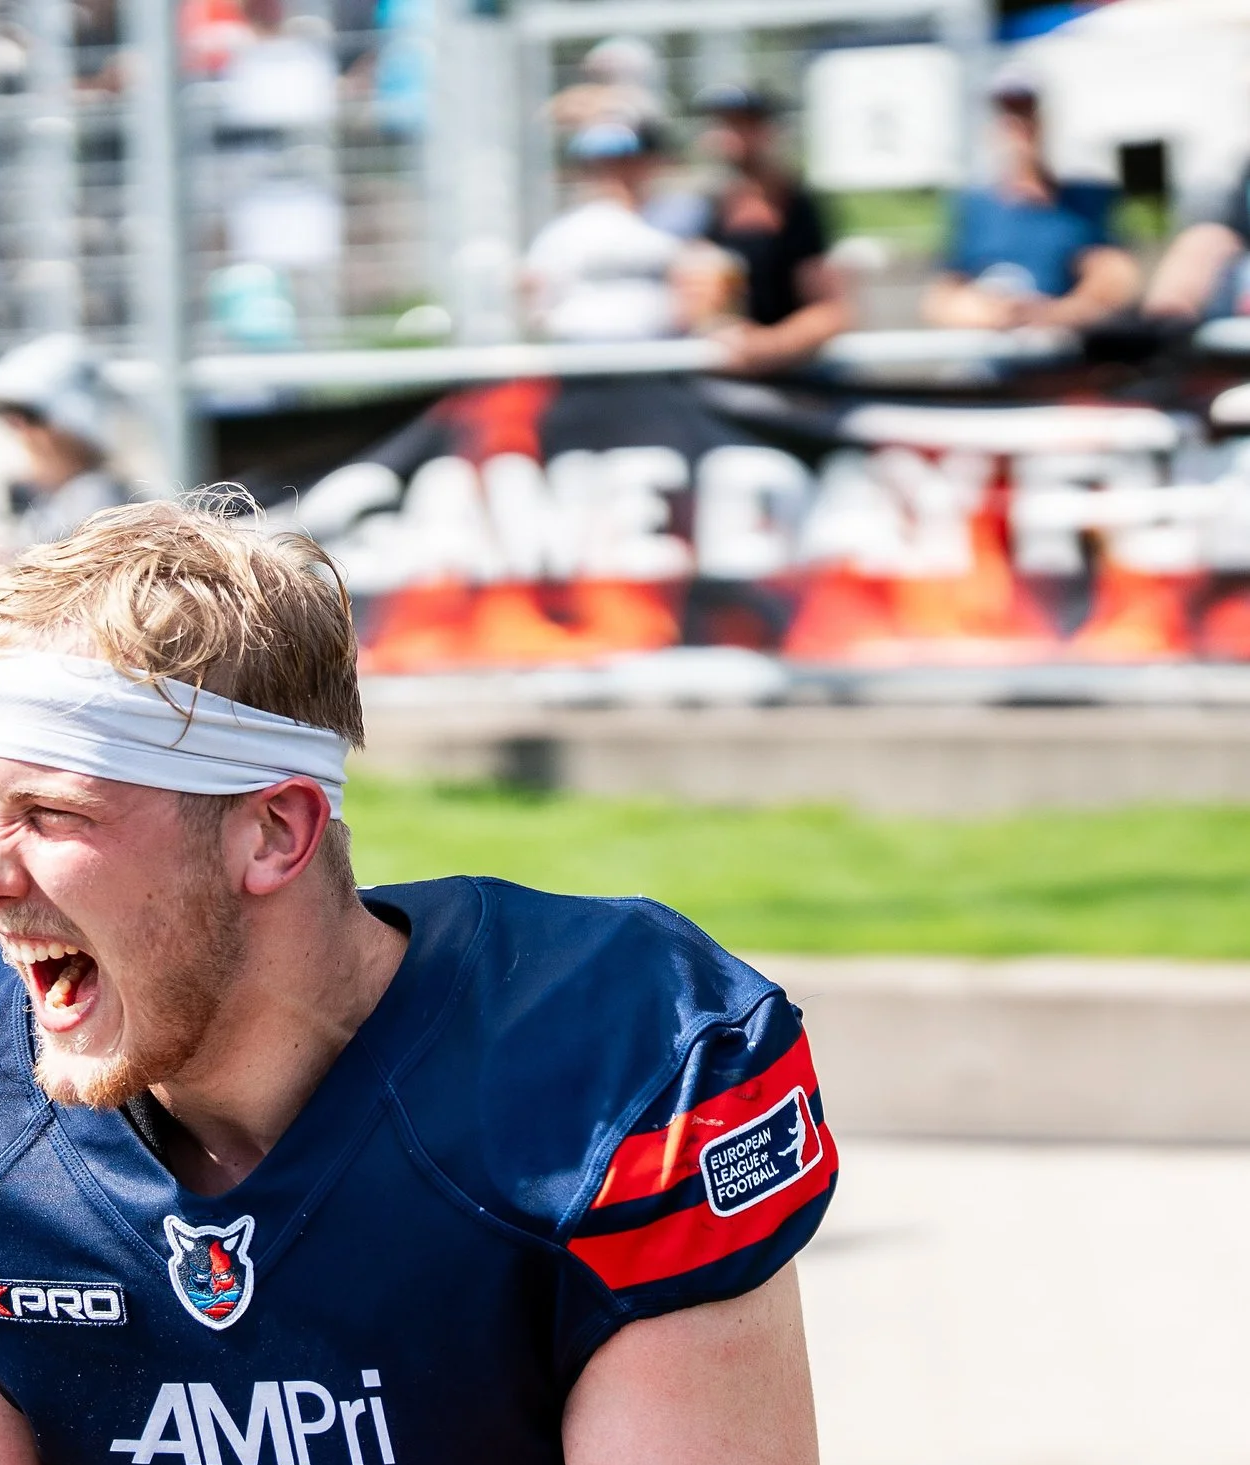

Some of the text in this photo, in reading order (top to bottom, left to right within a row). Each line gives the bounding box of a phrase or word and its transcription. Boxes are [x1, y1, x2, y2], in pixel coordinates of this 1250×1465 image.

[710, 1127, 772, 1170] EUROPEAN
[713, 1151, 769, 1187] LEAGUE OF
[717, 1161, 780, 1204] FOOTBALL
